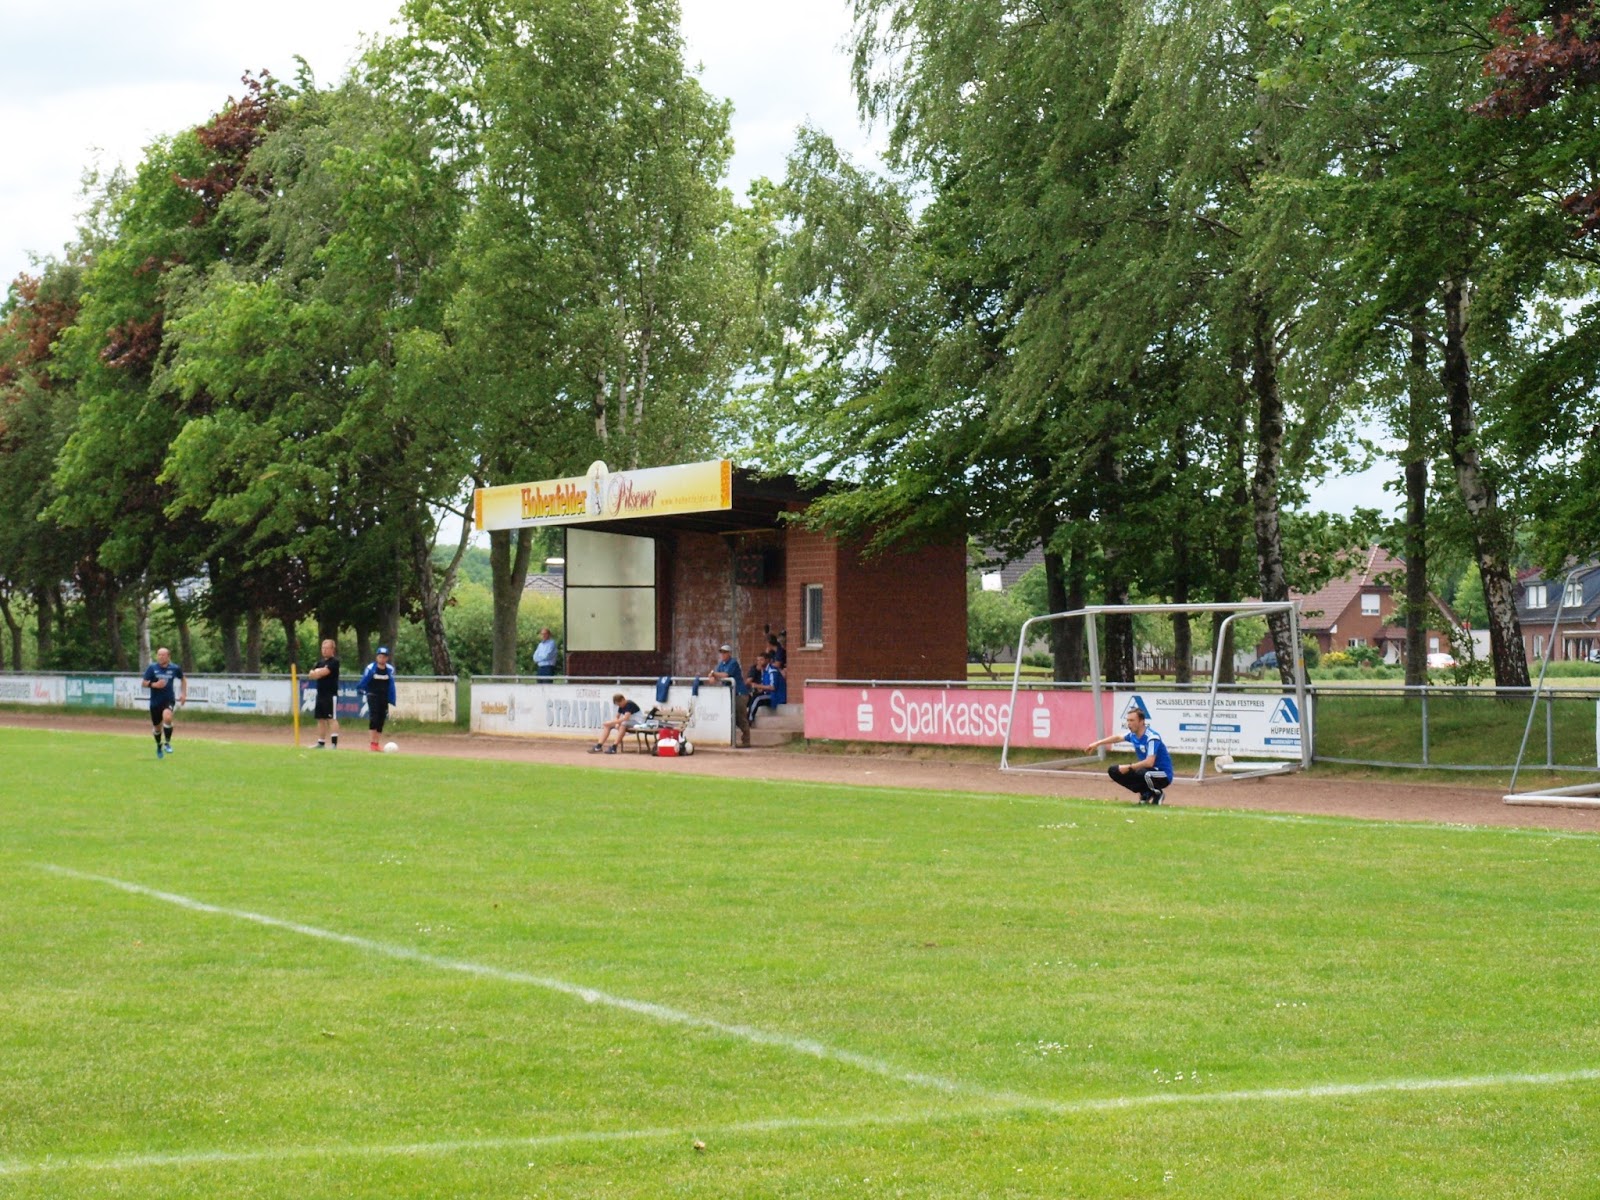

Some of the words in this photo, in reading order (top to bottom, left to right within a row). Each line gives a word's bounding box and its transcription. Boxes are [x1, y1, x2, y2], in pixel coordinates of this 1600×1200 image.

[521, 483, 587, 519] Hohenfelder
[608, 474, 657, 517] Pilsener
[890, 690, 1012, 741] Sparkasse
[1270, 725, 1300, 735] HÜPPMEIE
